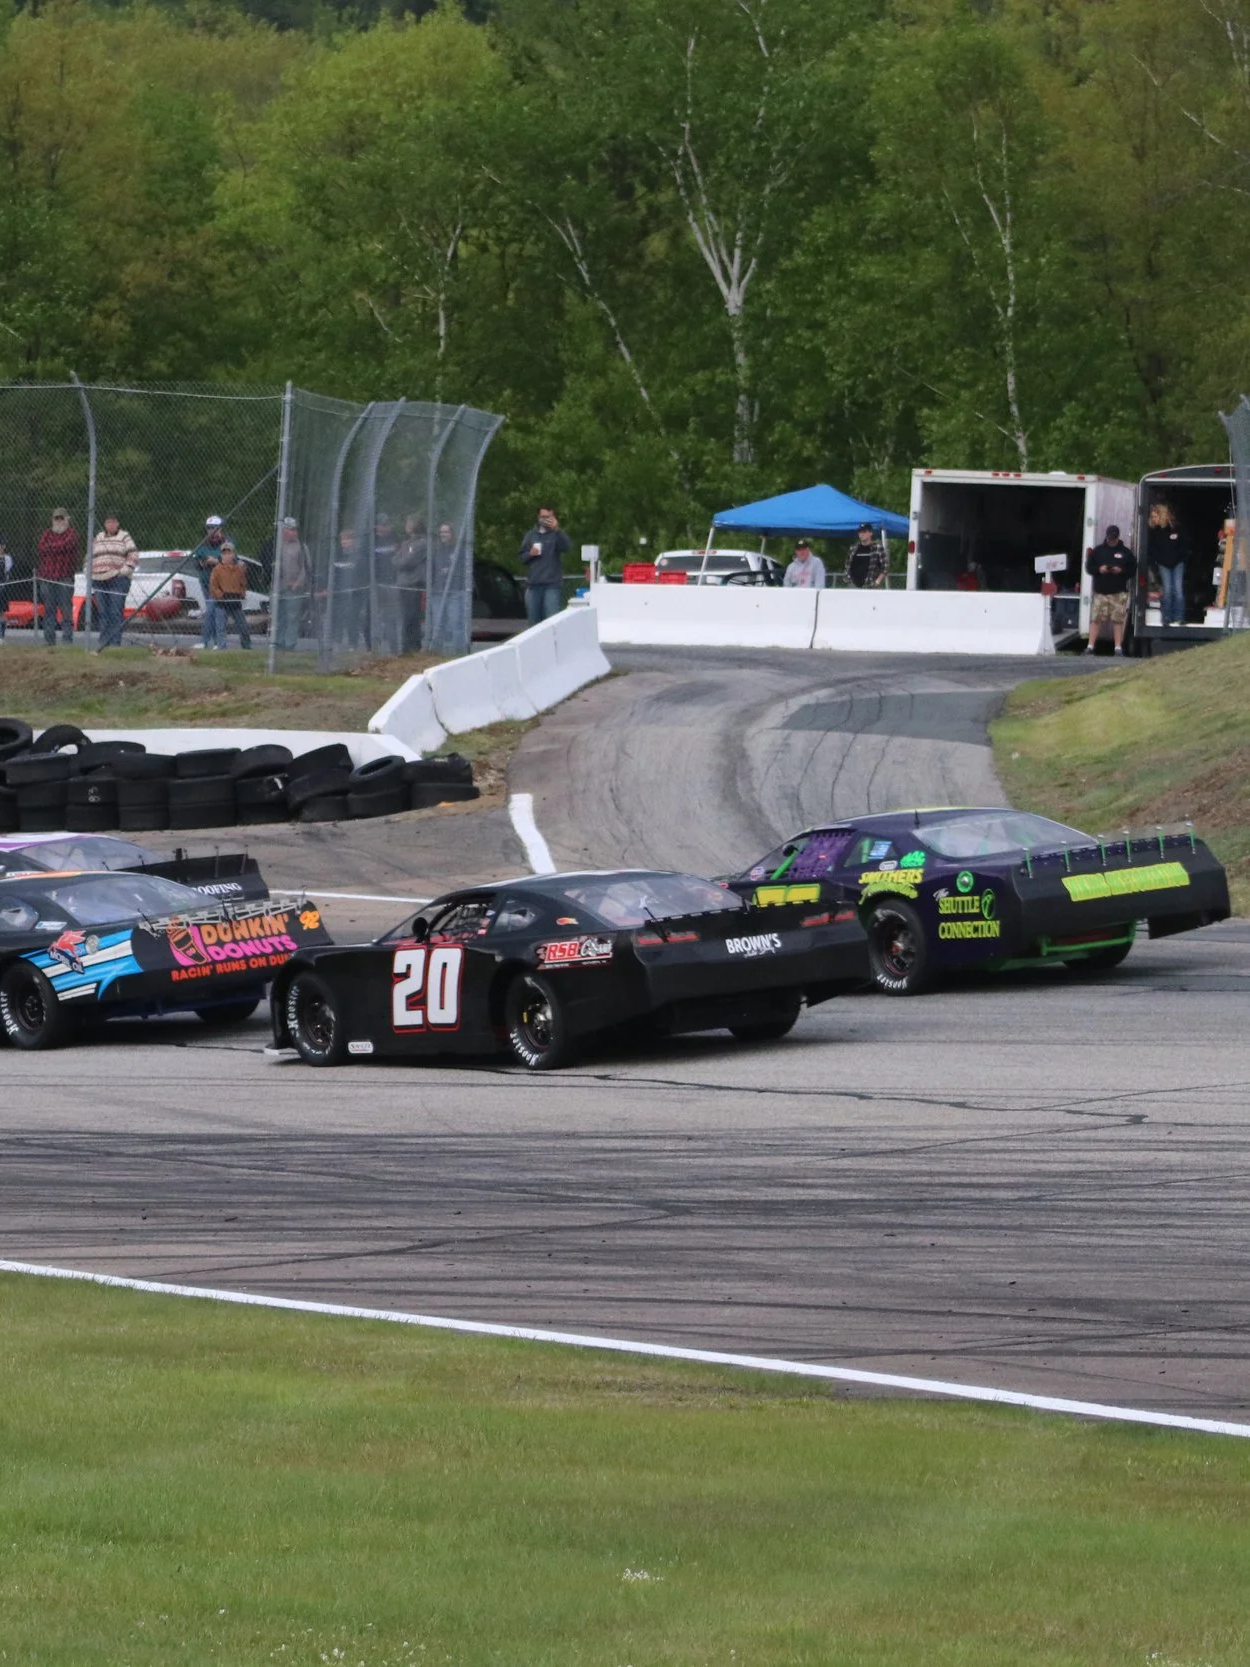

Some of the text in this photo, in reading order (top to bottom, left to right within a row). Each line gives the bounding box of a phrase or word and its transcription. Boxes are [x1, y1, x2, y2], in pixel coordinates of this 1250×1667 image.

[191, 883, 243, 895] OOFING
[939, 896, 981, 914] SHUTTLE
[199, 913, 290, 945] DUNKIN'
[299, 911, 320, 931] 92
[939, 921, 1000, 939] CONNECTION
[206, 935, 299, 961] DONUTS
[546, 942, 580, 961] RSB
[725, 933, 782, 954] BROWN'S
[171, 966, 213, 982] RACIN'
[216, 958, 247, 975] RUNS
[249, 956, 268, 968] ON
[392, 944, 464, 1033] 20
